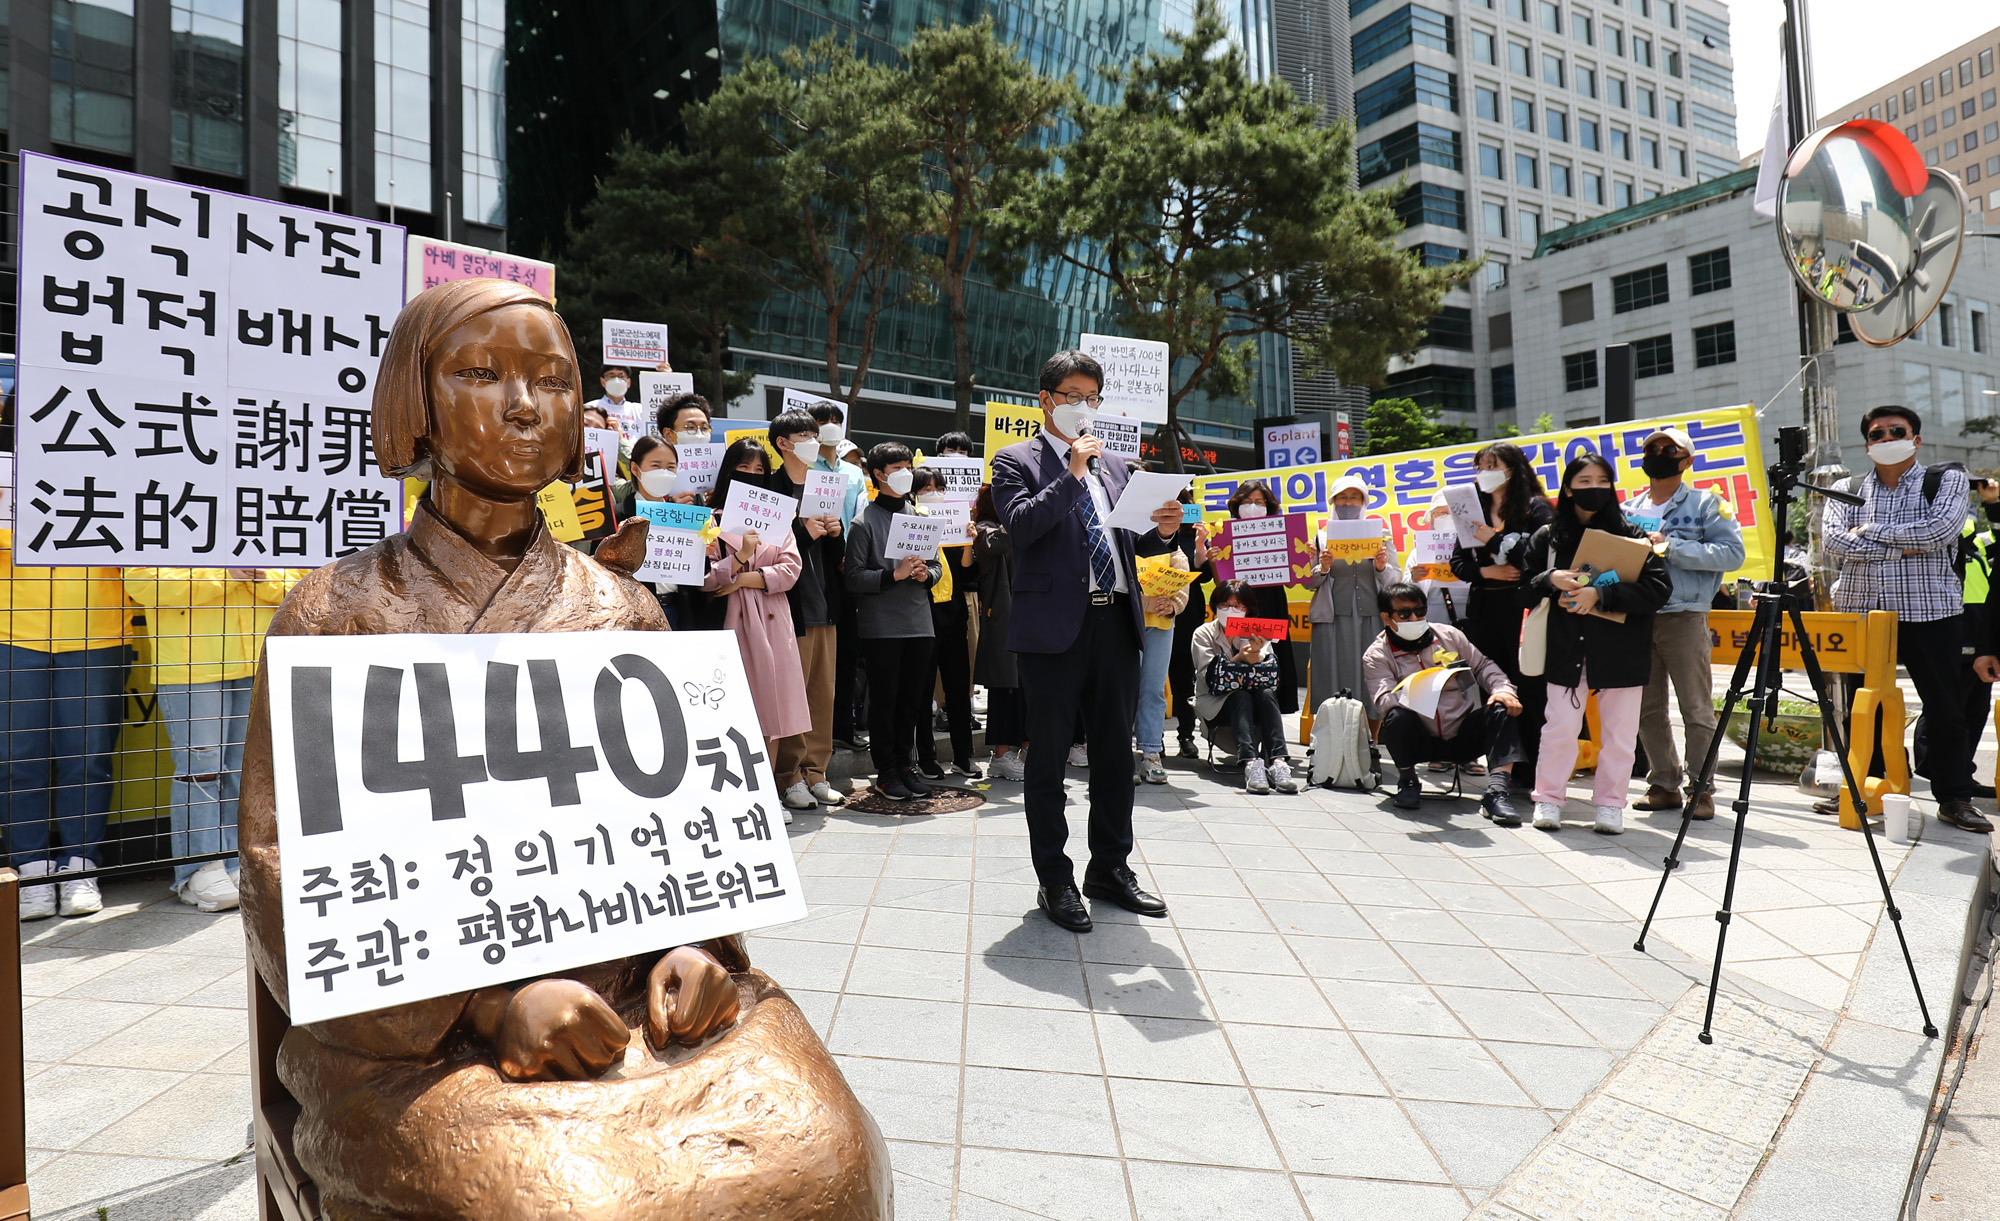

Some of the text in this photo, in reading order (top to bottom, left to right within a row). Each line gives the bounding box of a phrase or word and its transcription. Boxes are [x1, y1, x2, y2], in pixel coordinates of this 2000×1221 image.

[43, 168, 382, 280] 공식 사죄
[425, 246, 455, 270] 아베
[43, 274, 390, 393] 법적 배상
[611, 348, 661, 360] 계속되어야한다
[1089, 344, 1164, 362] 친일 반민족 100년
[1119, 362, 1161, 378] 나대느냐
[652, 384, 682, 395] 일본군
[1104, 377, 1165, 397] 동아 일본놈아
[29, 384, 374, 477] 公式謝罪
[1107, 431, 1138, 443] 한일합의
[1267, 429, 1317, 445] G.plant
[683, 447, 712, 457] 언론의
[1104, 441, 1138, 453] 시도말라!
[679, 460, 718, 471] 제목장사
[1274, 452, 1287, 467] P
[689, 474, 712, 483] OUT
[821, 475, 841, 485] 언론의
[960, 476, 981, 486] 30년
[748, 489, 780, 506] 언론의
[814, 486, 841, 497] 제목장사
[738, 500, 782, 521] 제목장사
[819, 501, 836, 509] OUT
[27, 476, 391, 557] 法的賠償
[640, 506, 708, 525] 사랑합니다
[744, 517, 770, 532] OUT
[901, 521, 938, 532] 수요시위는
[1233, 519, 1284, 532] 위안부 문제를
[647, 533, 694, 547] 수요시위는
[908, 532, 930, 542] 평화의
[1234, 537, 1286, 550] 올바로 알리는
[653, 547, 683, 559] 평화의
[896, 541, 933, 552] 상징입니다
[643, 559, 691, 572] 상징입니다
[1235, 556, 1251, 566] 오랜
[1242, 571, 1283, 582] 응원합니다
[1228, 620, 1286, 633] 사랑합니다
[1288, 614, 1311, 629] NE
[290, 653, 765, 837] 1440차
[300, 852, 420, 917] 주최:
[304, 861, 787, 993] 주관: 평화나비네트워크
